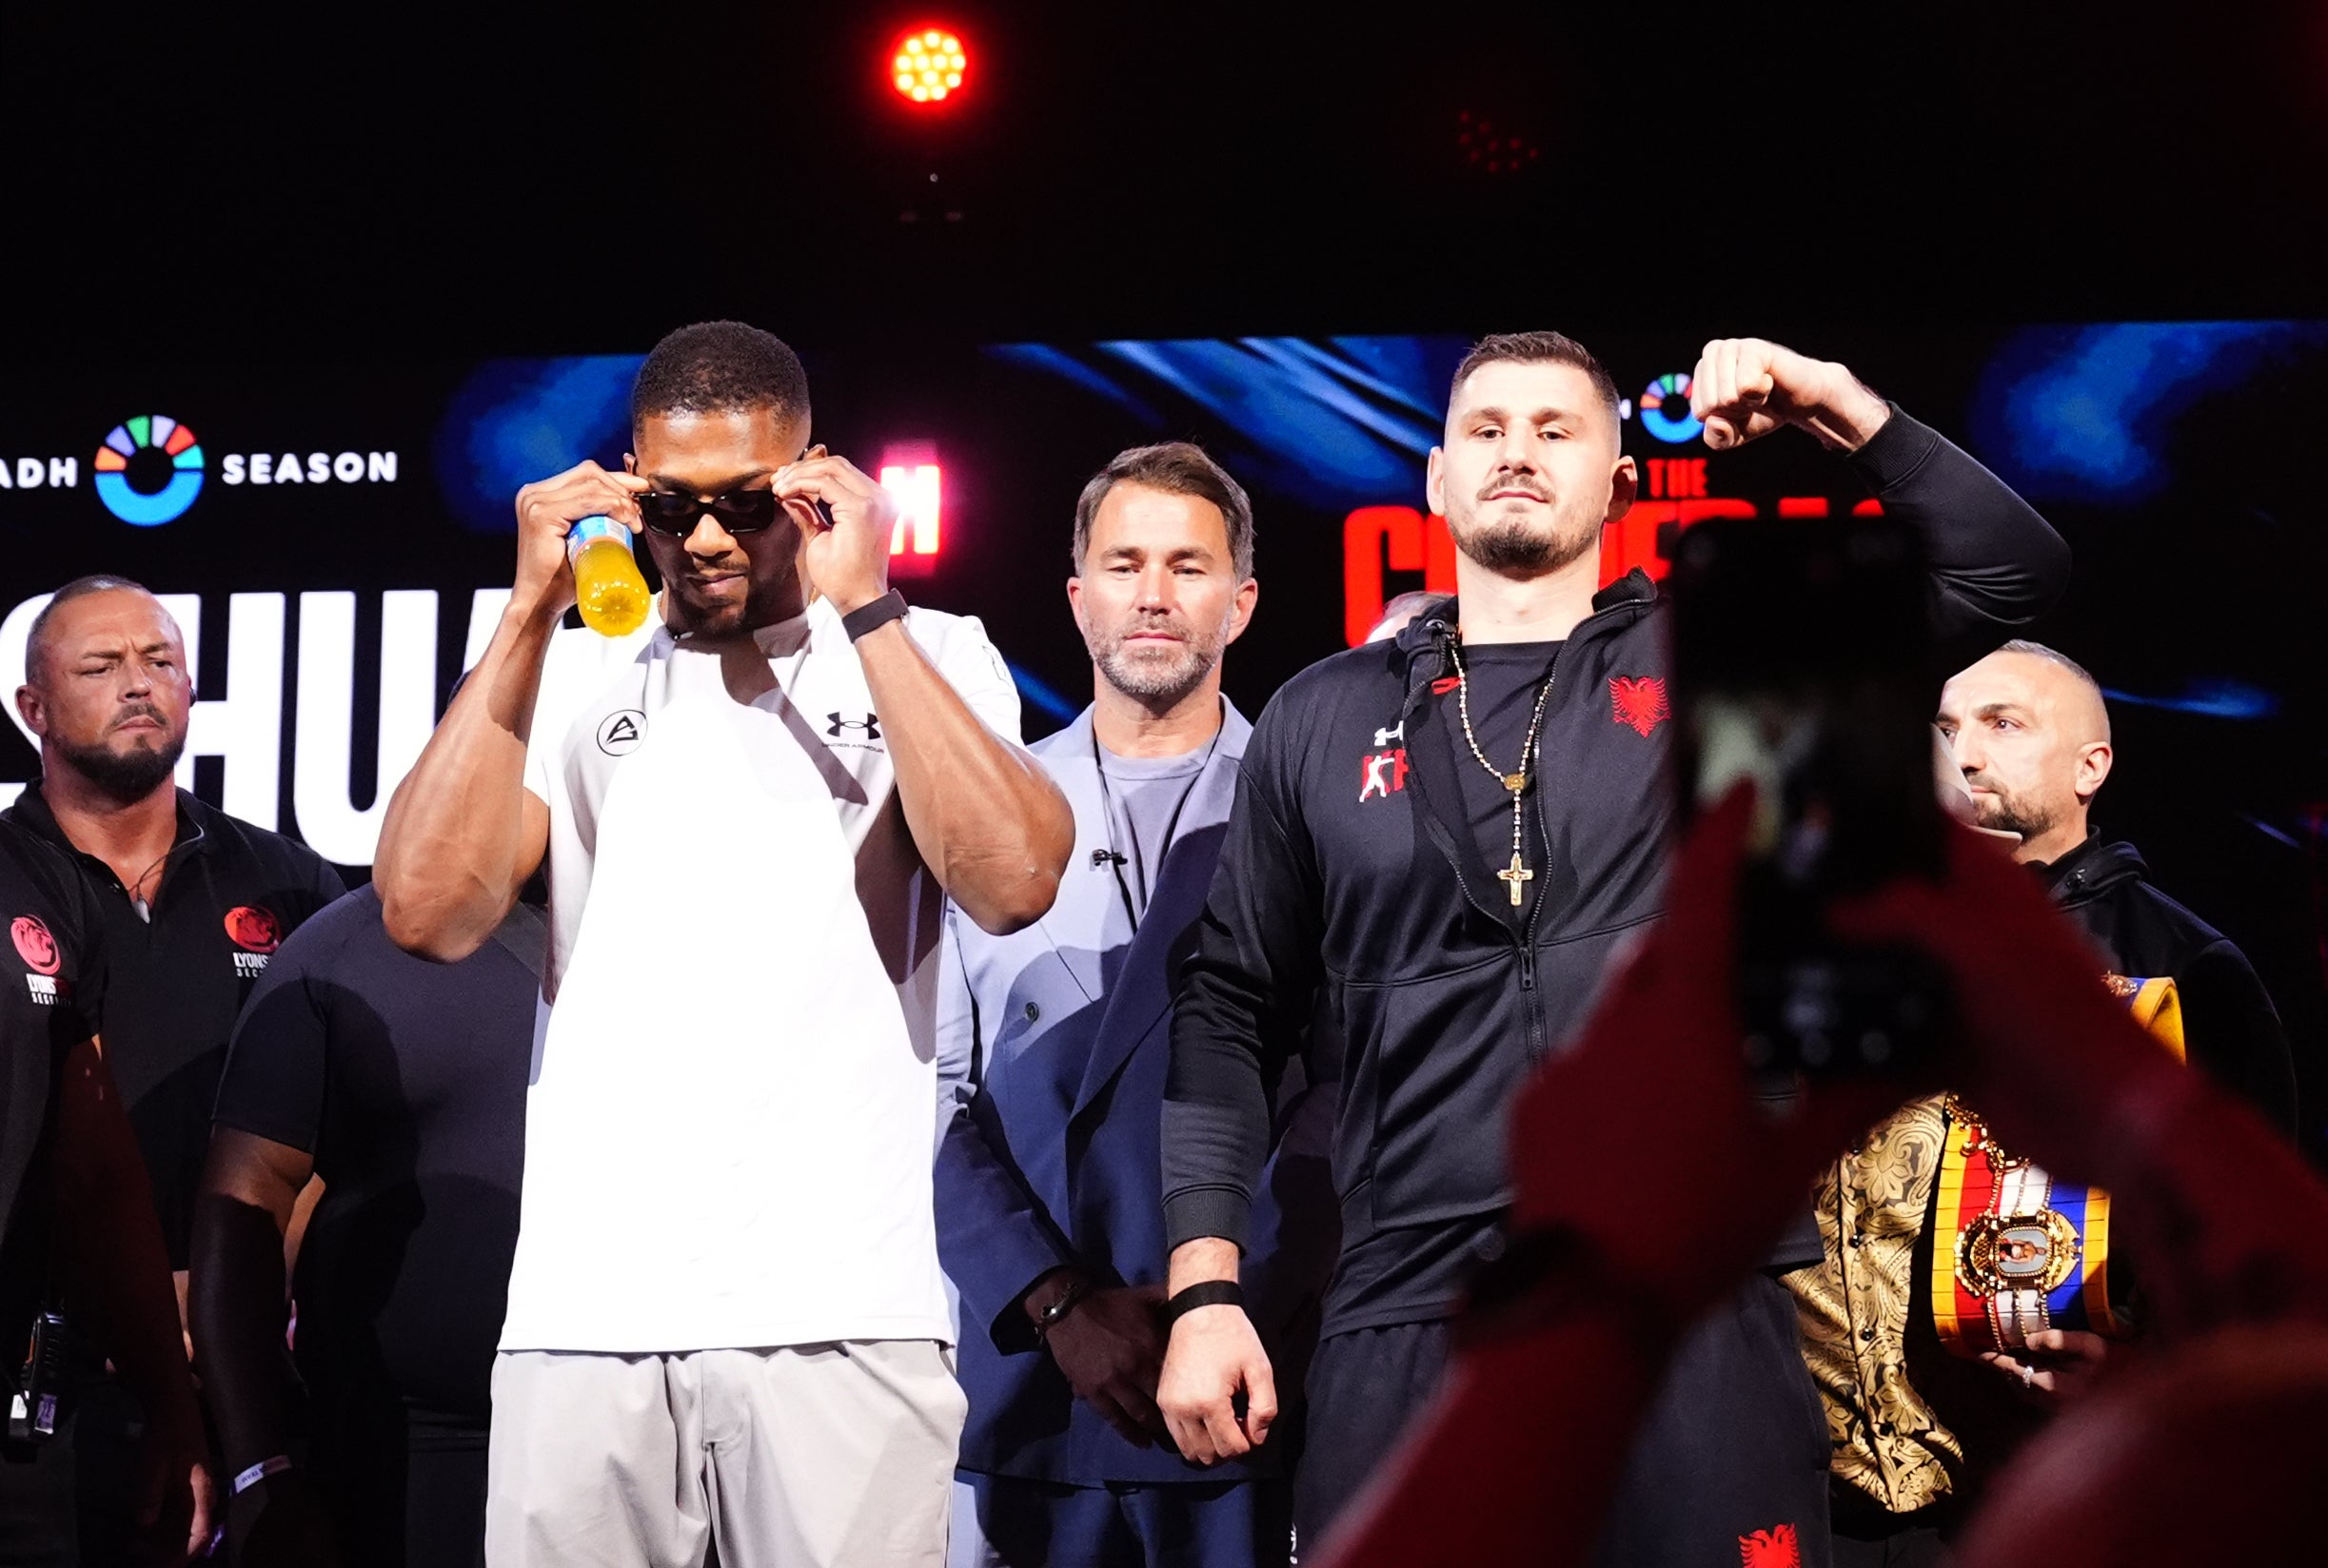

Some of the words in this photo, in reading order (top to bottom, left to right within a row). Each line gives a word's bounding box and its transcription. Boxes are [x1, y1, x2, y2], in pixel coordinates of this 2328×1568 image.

[222, 451, 398, 485] SEASON
[1646, 457, 1710, 498] THE
[232, 951, 268, 970] LYONS
[235, 968, 264, 978] SEC
